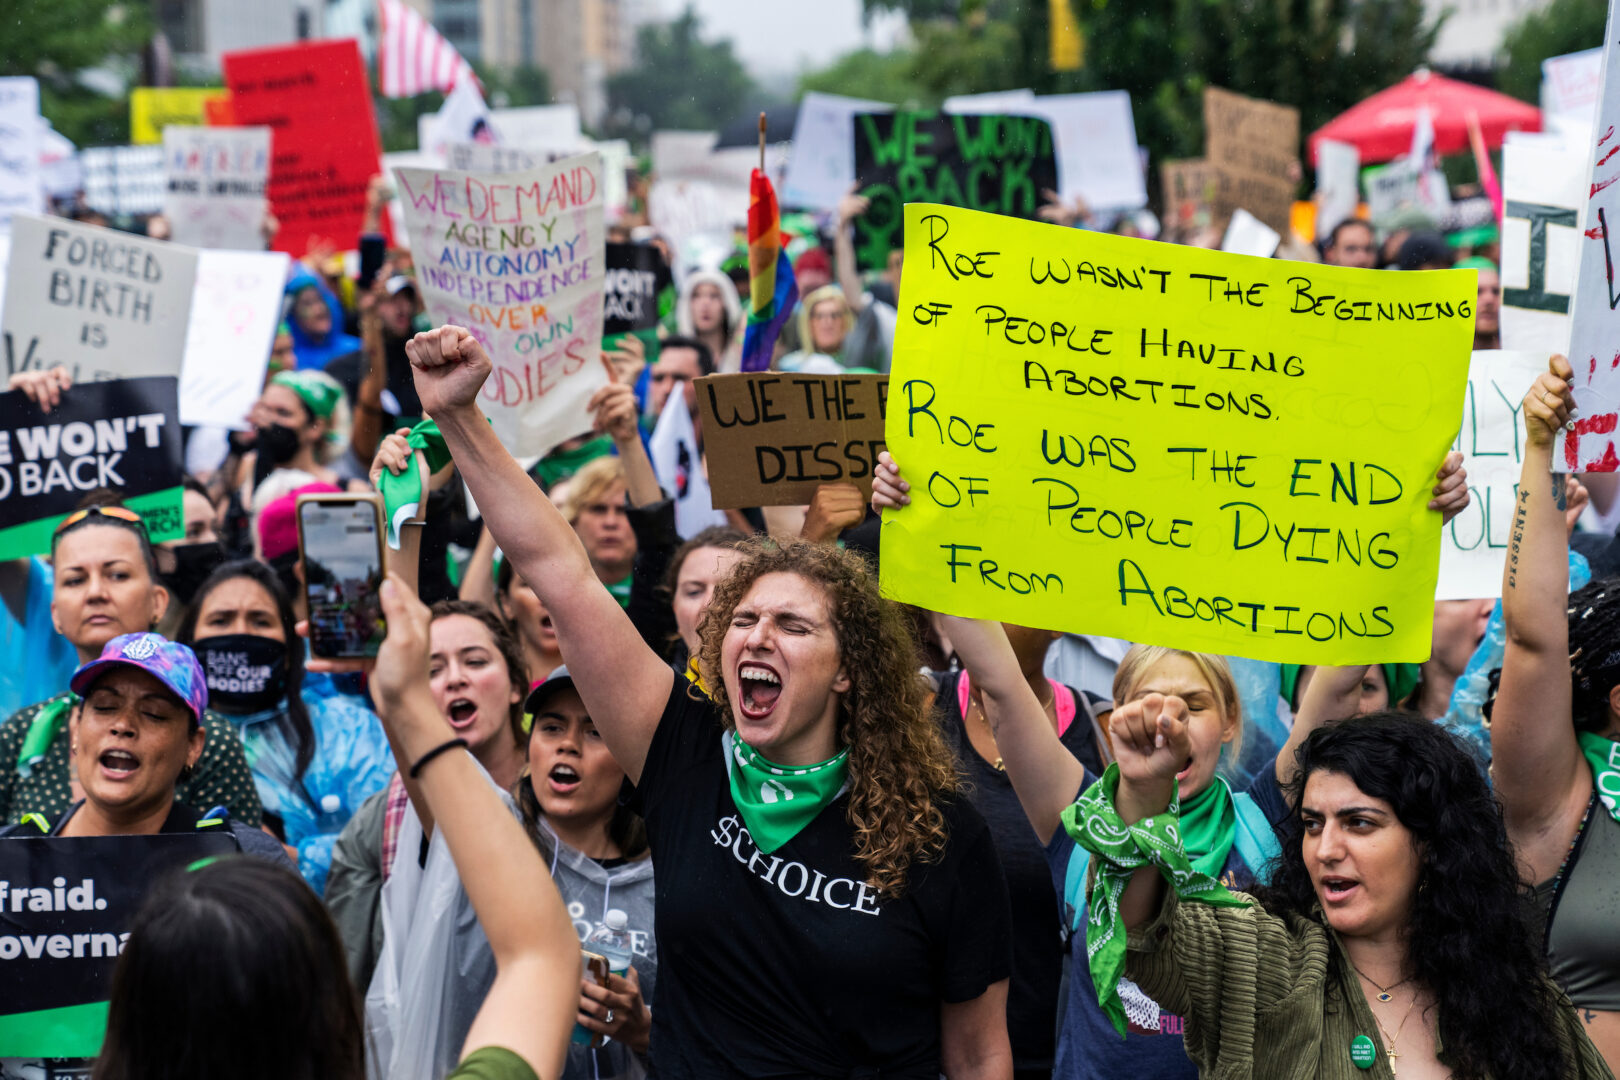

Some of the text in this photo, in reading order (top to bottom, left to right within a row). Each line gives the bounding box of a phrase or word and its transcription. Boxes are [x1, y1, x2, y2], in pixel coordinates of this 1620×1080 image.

[860, 109, 940, 166] WE
[398, 166, 597, 223] WE DEMAND
[898, 157, 1036, 215] BACK
[44, 229, 162, 284] FORCED
[439, 234, 580, 277] AUTONOMY
[446, 217, 557, 250] AGENCY
[421, 257, 593, 304] INDEPENDENCE
[920, 214, 1472, 321] ROE WASN'T THE BEGINNING
[49, 270, 155, 324] BIRTH
[469, 304, 549, 331] OVER
[604, 296, 645, 321] ACK
[80, 322, 108, 349] IS
[515, 315, 573, 354] OWN
[913, 302, 1305, 377] OF PEOPLE HAVING
[482, 338, 586, 407] ODIES
[1024, 360, 1280, 421] ABORTIONS.
[707, 379, 786, 428] WE
[792, 379, 866, 421] THE
[16, 413, 166, 462] WON'T
[902, 379, 997, 453] ROE
[1041, 429, 1136, 472] WAS
[1167, 447, 1257, 488] THE
[1289, 459, 1402, 506] END
[19, 452, 125, 497] BACK
[928, 471, 1399, 570] OF PEOPLE DYING
[1118, 558, 1394, 641] ABORTIONS
[207, 676, 265, 693] BODIES
[236, 665, 272, 680] OUR
